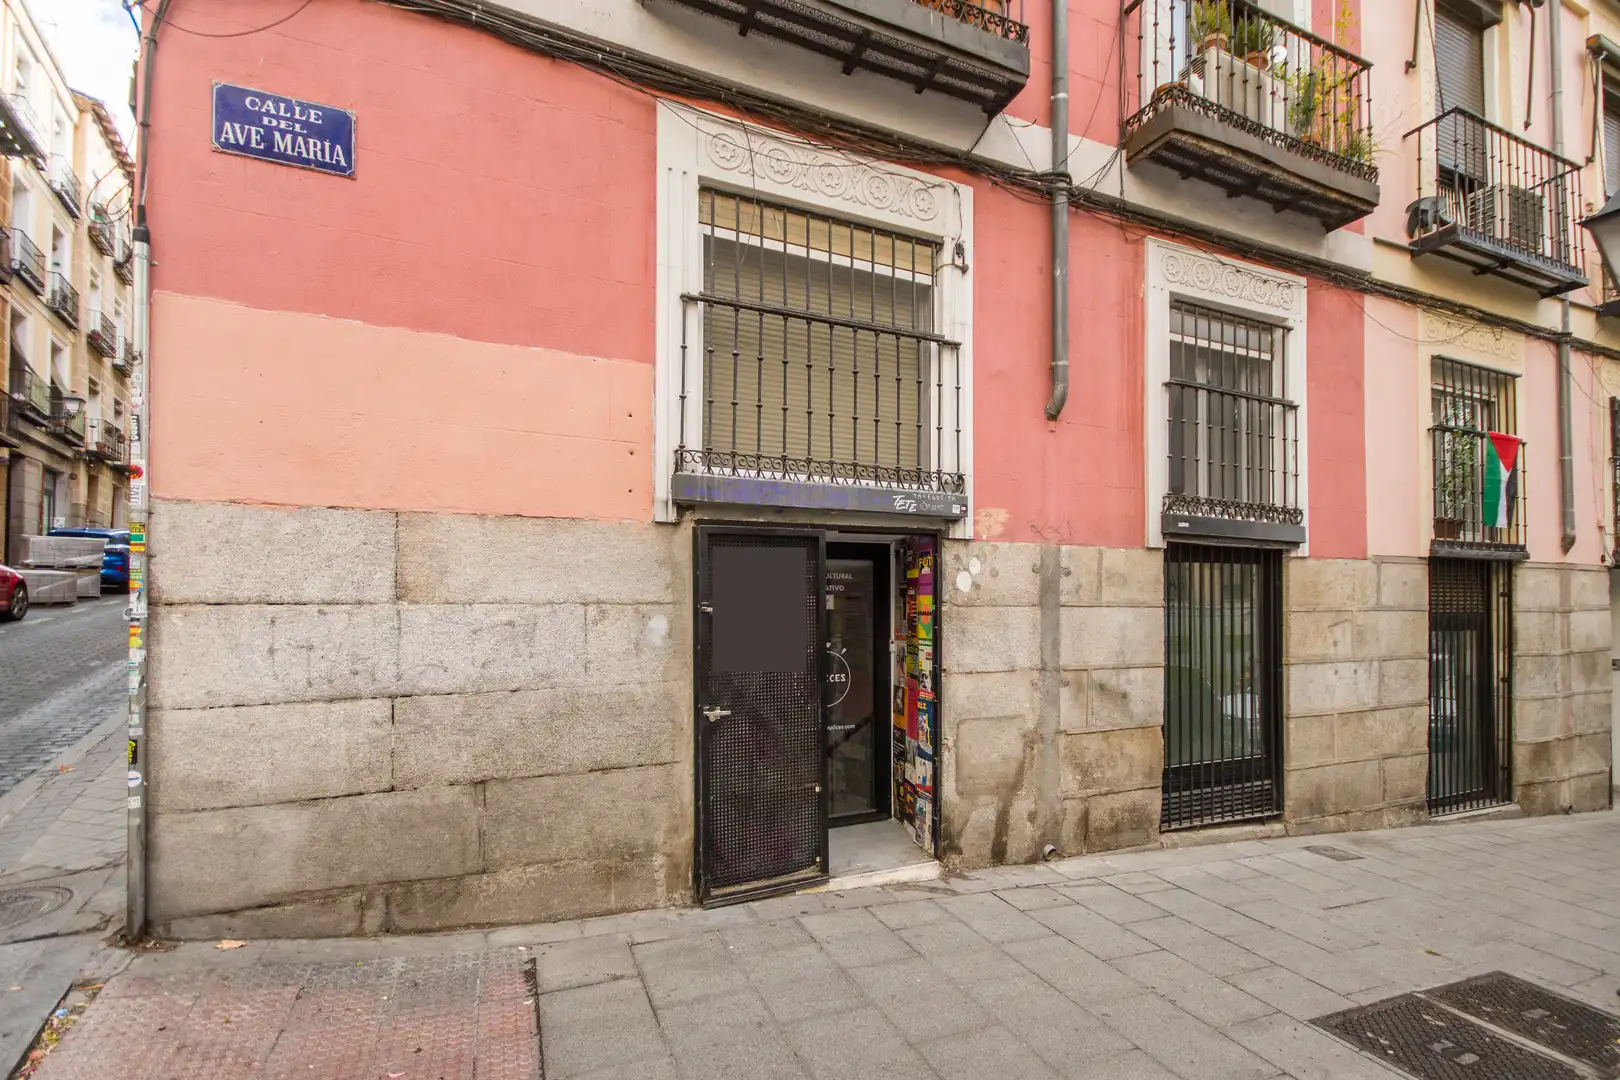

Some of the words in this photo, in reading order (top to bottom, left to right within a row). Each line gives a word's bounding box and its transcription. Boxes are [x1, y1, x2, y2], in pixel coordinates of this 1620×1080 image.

[244, 96, 323, 124] CALLE
[219, 121, 265, 149] AVE
[262, 116, 307, 133] DEL
[826, 673, 846, 683] CES
